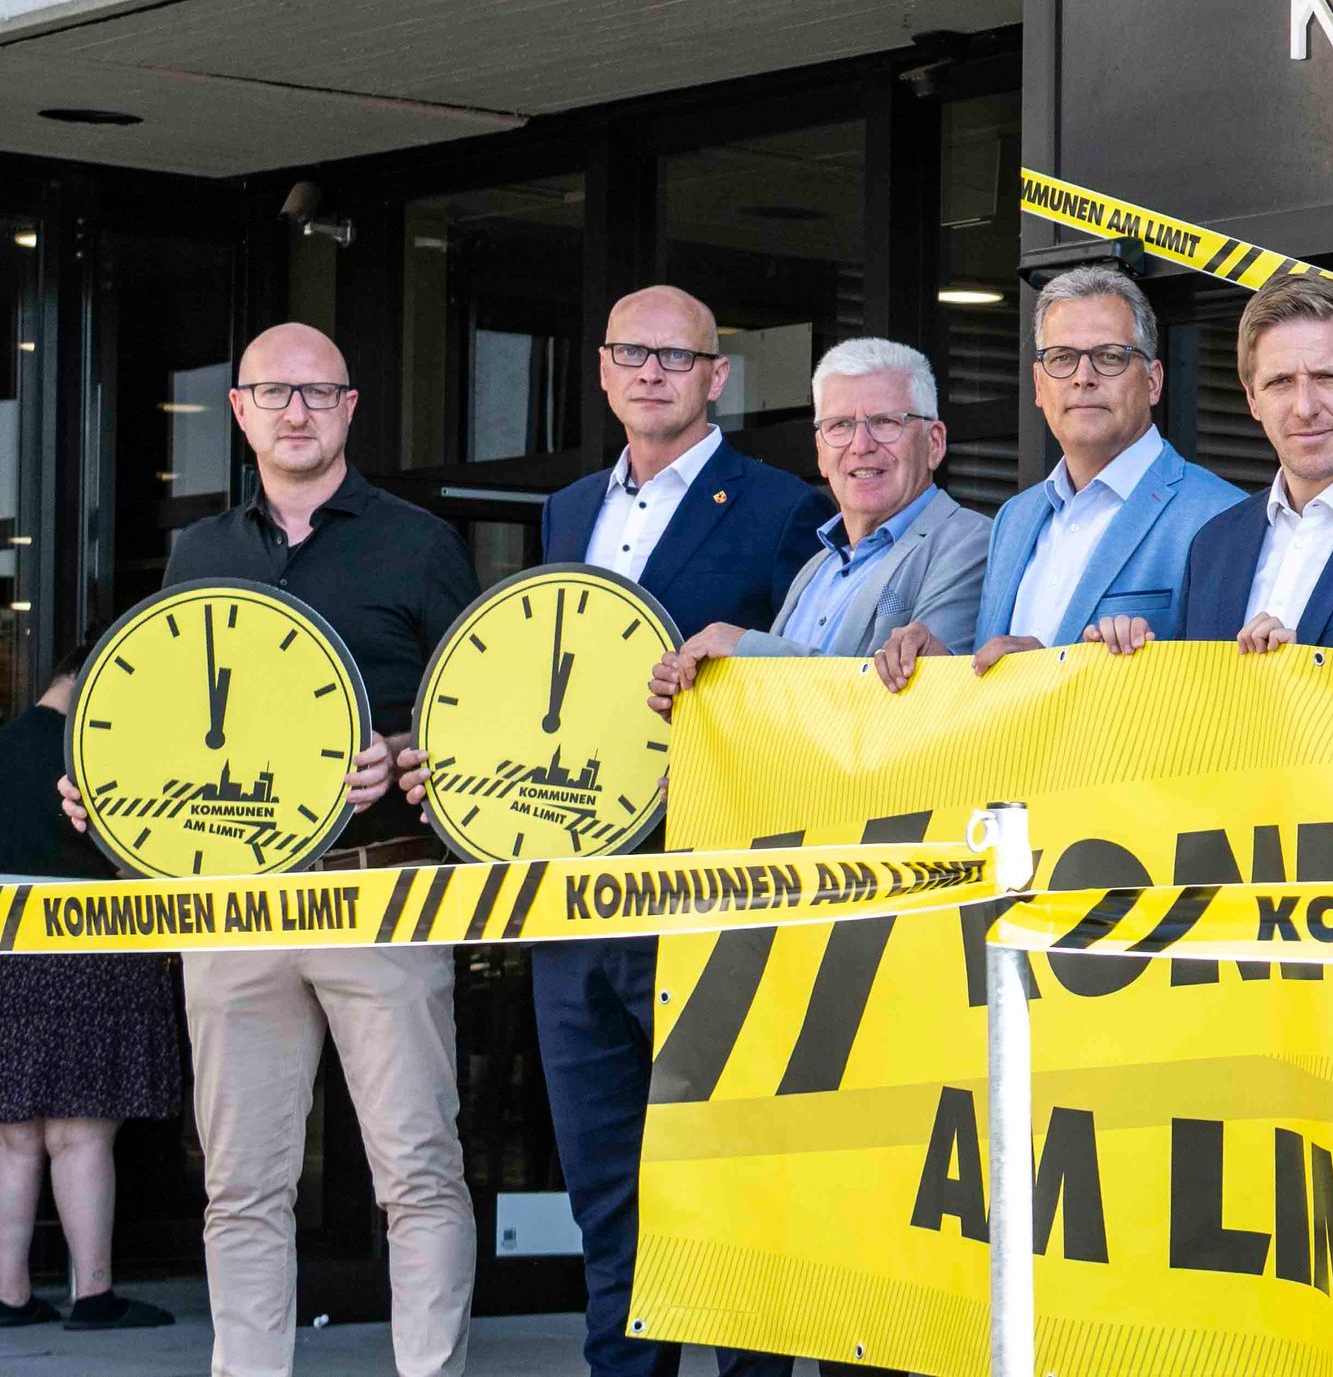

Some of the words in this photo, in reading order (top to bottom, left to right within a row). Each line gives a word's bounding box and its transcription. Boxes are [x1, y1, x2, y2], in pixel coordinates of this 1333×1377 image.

[1106, 208, 1141, 239] AM
[1144, 219, 1202, 258] LIMIT
[190, 804, 275, 818] KOMMUNEN
[510, 801, 531, 815] AM
[533, 806, 568, 825] LIMIT
[519, 786, 597, 806] KOMMUNEN
[183, 819, 206, 832] AM
[208, 823, 246, 839] LIMIT
[565, 863, 802, 920] KOMMUNEN
[811, 861, 879, 906] AM
[43, 892, 216, 937] KOMMUNEN
[224, 890, 273, 933] AM
[279, 886, 361, 931] LIMIT
[910, 1085, 1110, 1264] AM
